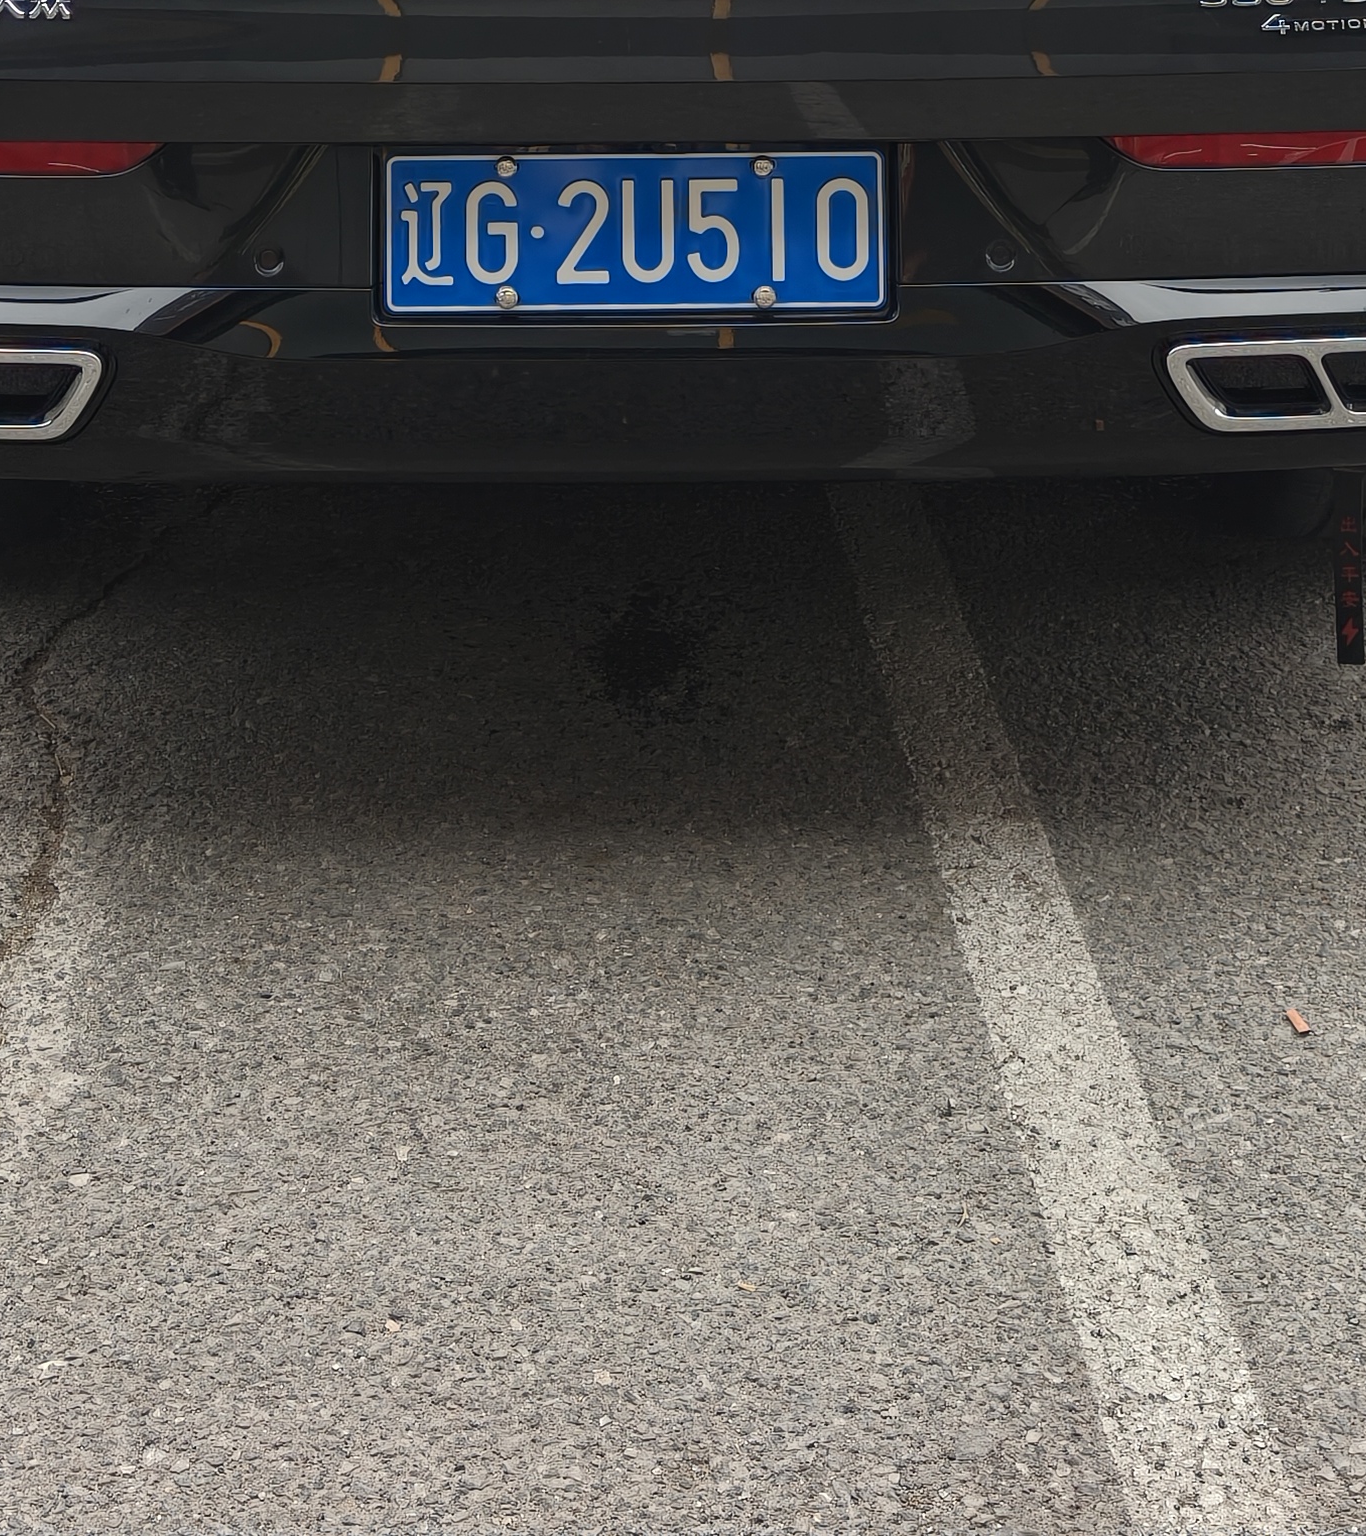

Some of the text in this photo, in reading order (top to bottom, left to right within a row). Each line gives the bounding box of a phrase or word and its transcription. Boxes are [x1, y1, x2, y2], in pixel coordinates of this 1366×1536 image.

[400, 176, 870, 287] 辽G·2U510
[1339, 516, 1360, 609] 出入平安
